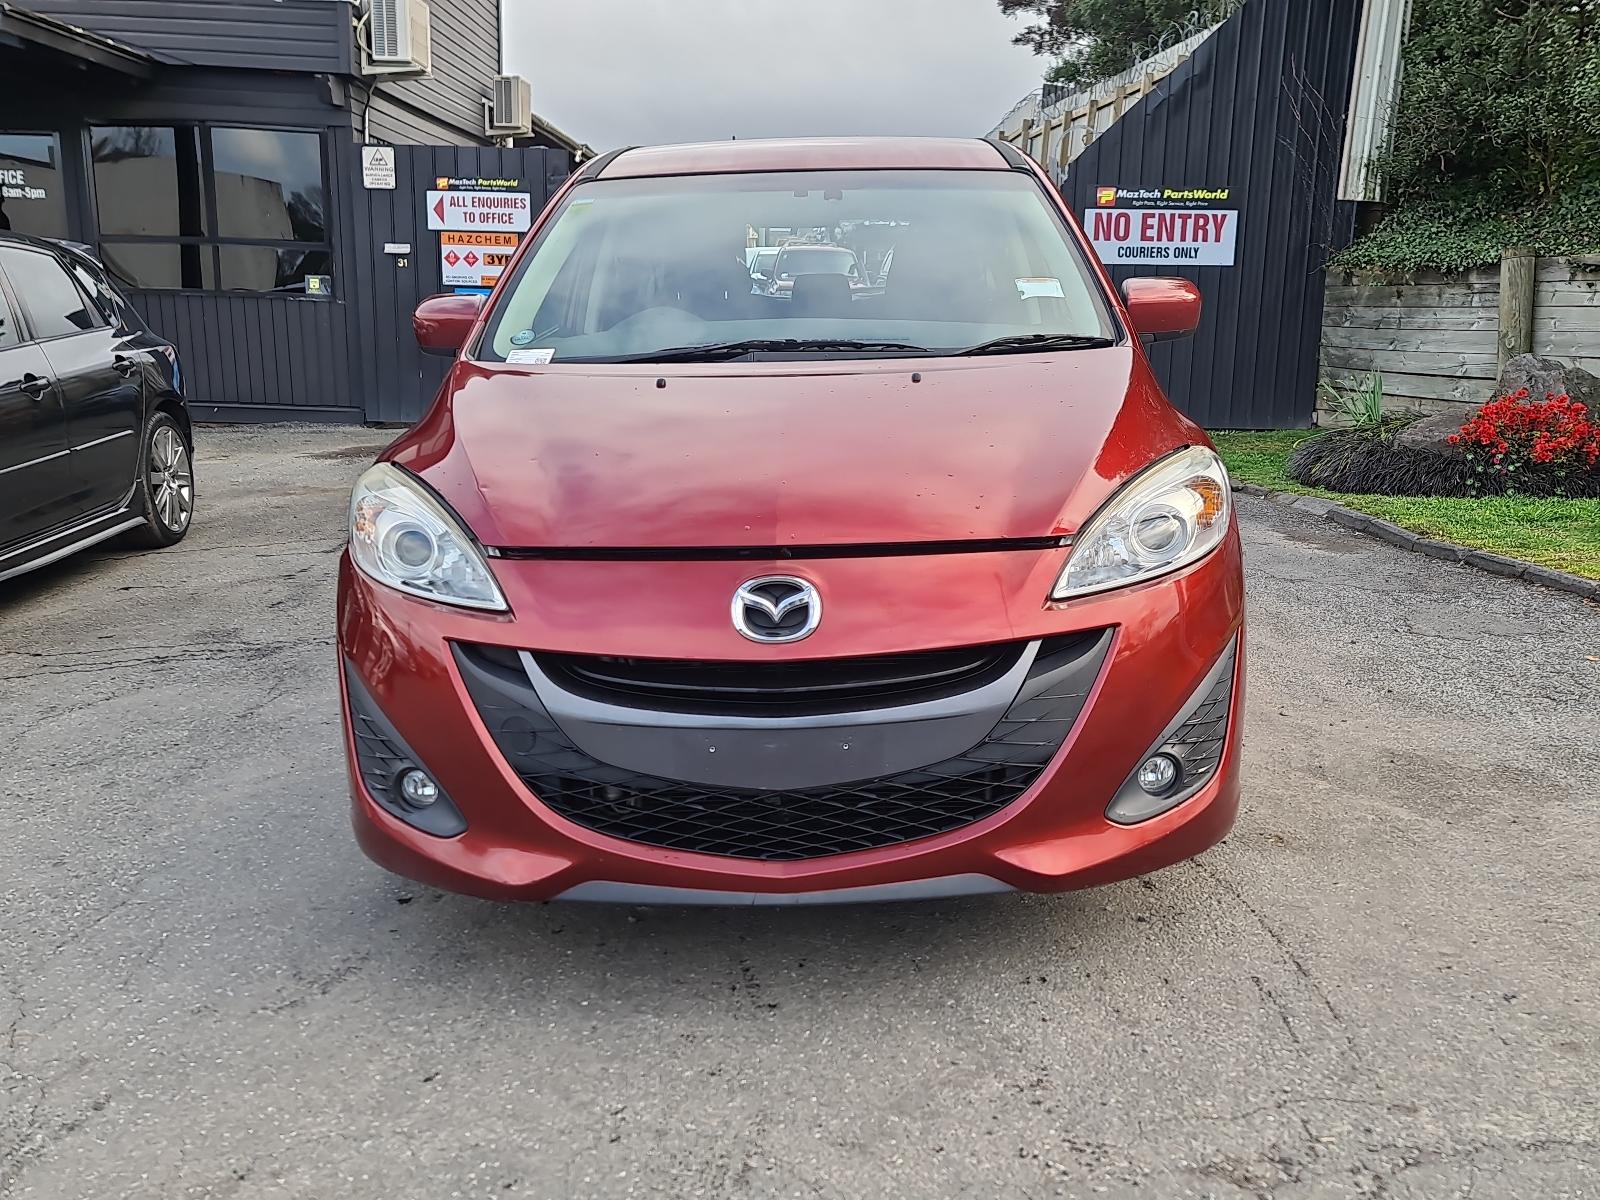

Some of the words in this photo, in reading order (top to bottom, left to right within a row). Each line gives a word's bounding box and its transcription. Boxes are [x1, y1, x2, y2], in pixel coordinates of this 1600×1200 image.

[478, 178, 518, 186] PartsWorld
[1116, 189, 1161, 198] MazTech
[1163, 189, 1229, 200] PartsWorld
[450, 196, 468, 208] ALL
[472, 196, 526, 210] ENQUIRIES
[463, 212, 476, 223] TO
[480, 212, 514, 224] OFFICE
[1093, 212, 1130, 241] NO
[1140, 213, 1228, 242] ENTRY
[448, 235, 512, 245] HAZCHEM
[1117, 246, 1170, 258] COURIERS
[1174, 247, 1199, 259] ONLY
[398, 258, 408, 267] 31
